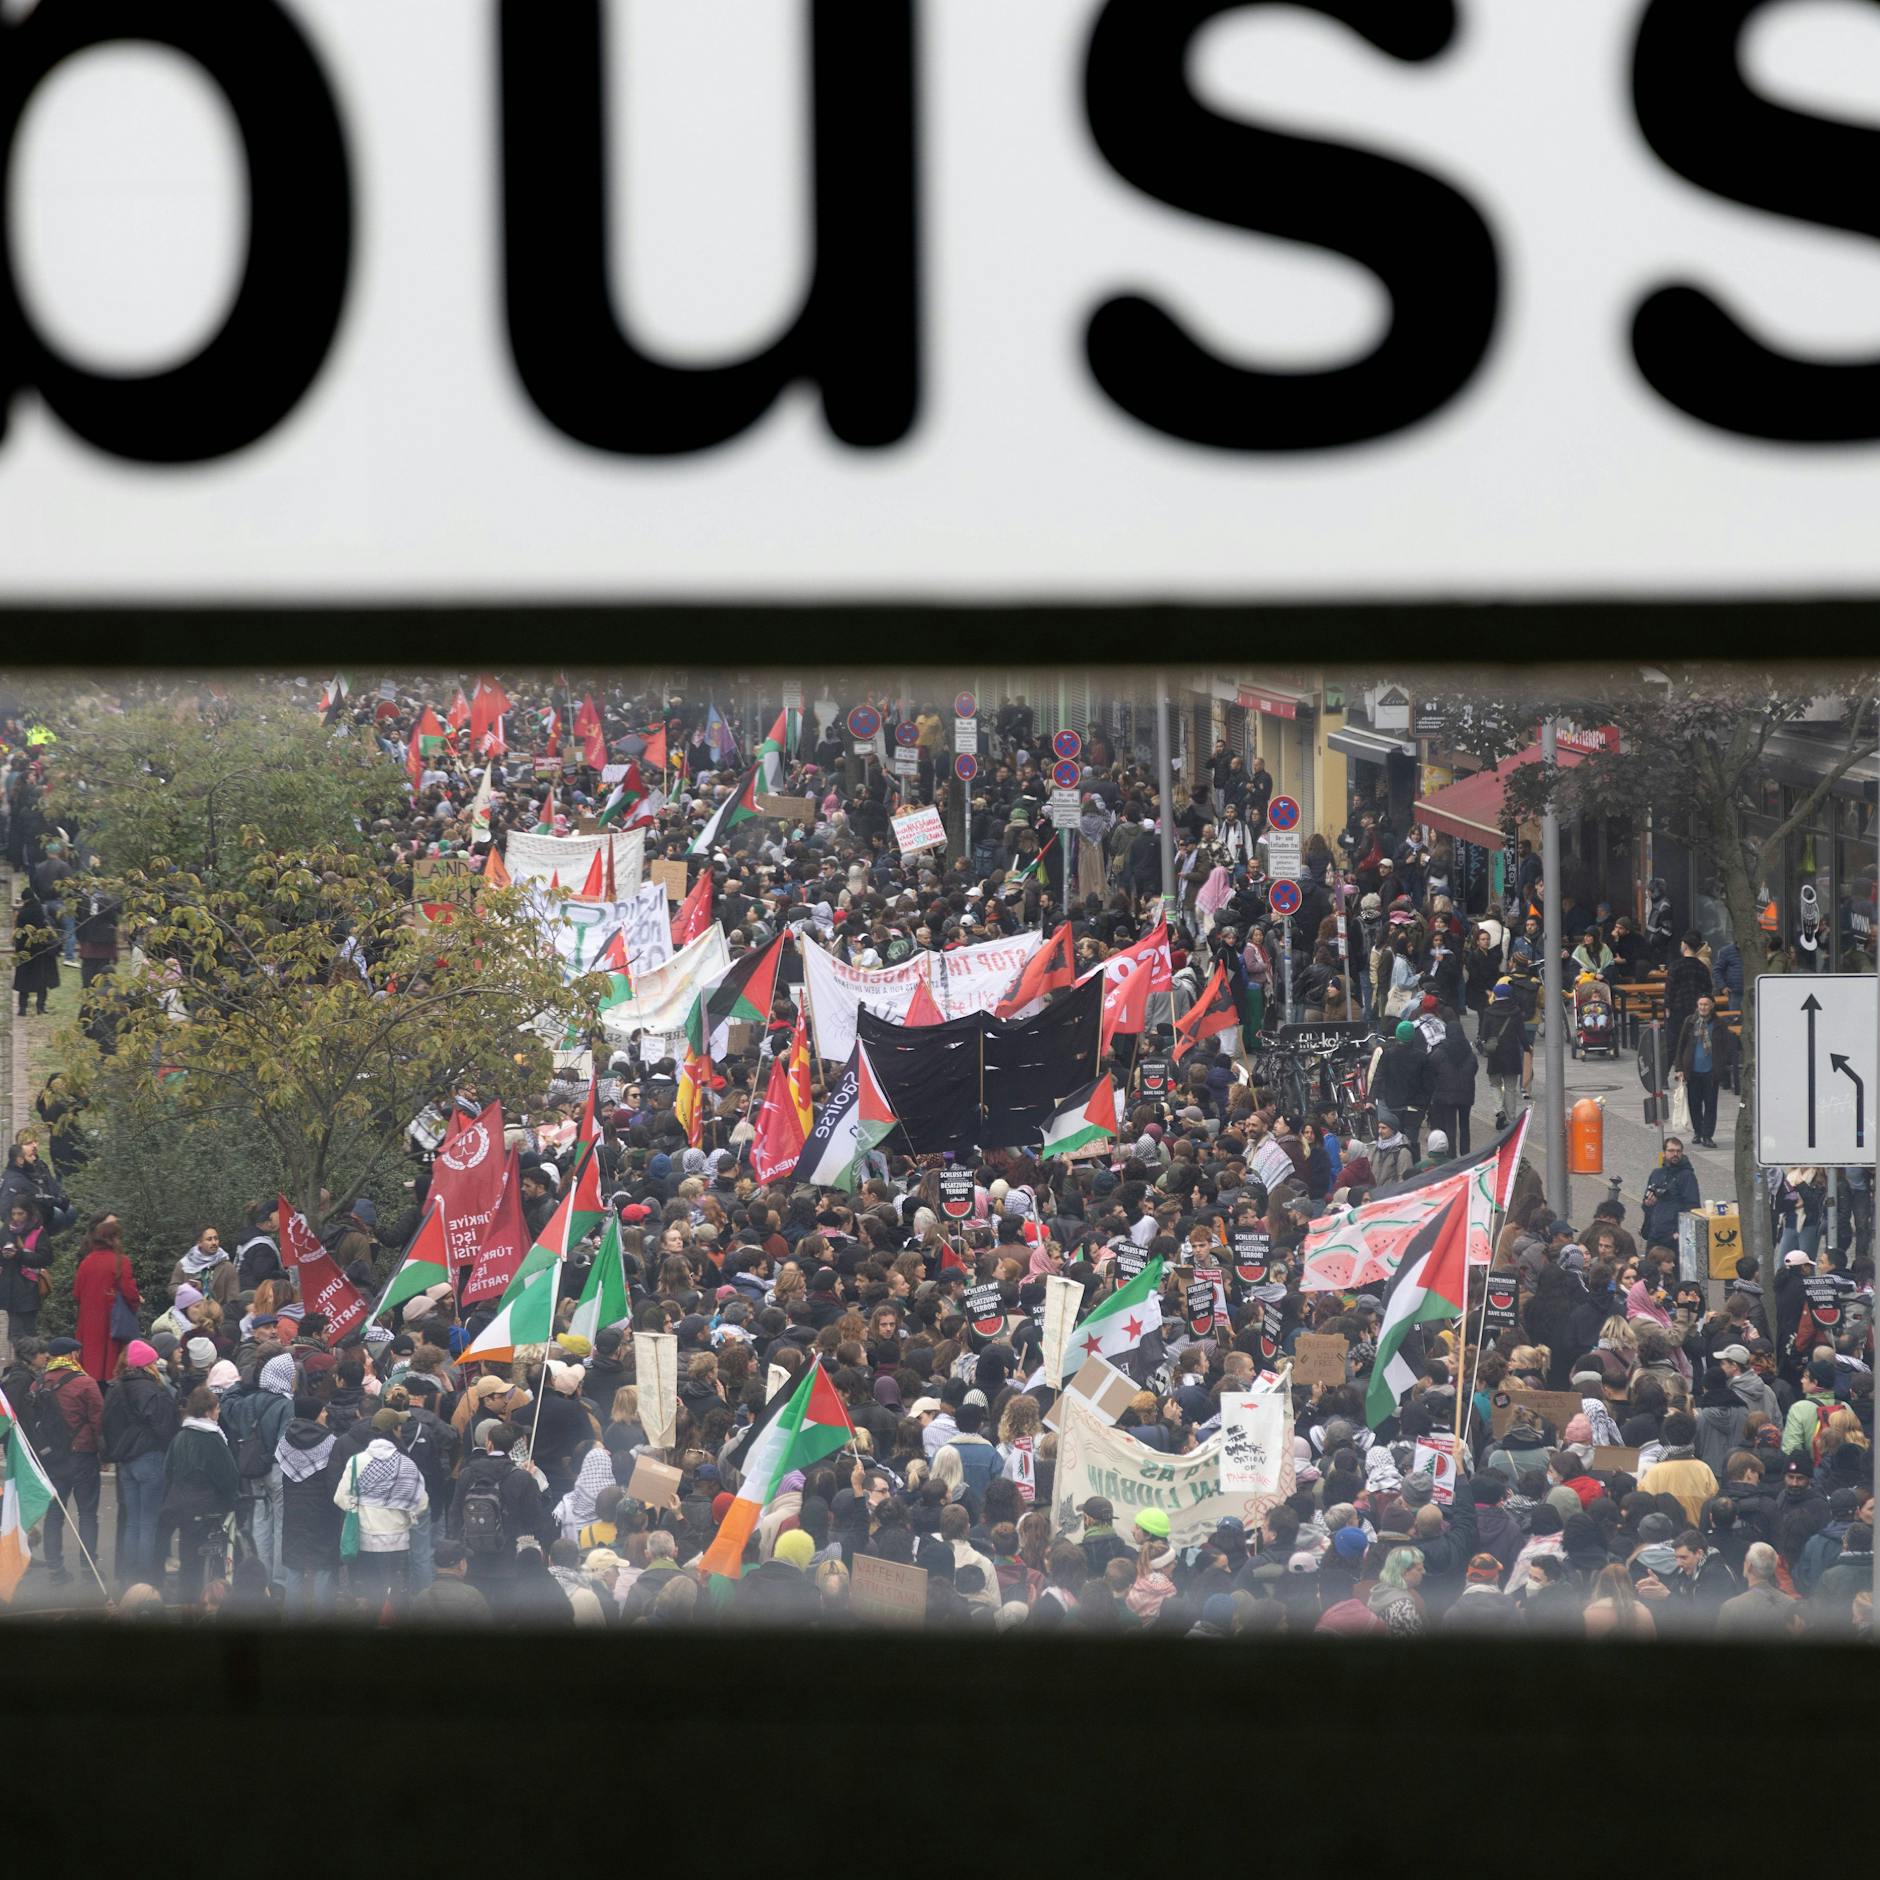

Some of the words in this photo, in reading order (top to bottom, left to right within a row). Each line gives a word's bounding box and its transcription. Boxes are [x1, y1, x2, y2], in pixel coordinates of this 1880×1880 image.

[940, 1171, 963, 1179] SCHLUSS
[963, 1170, 973, 1178] MIT
[940, 1181, 973, 1189] BESATZUNGS
[1235, 1233, 1257, 1241] SCHLUSS
[1118, 1244, 1139, 1255] SCHLUSS
[1235, 1245, 1269, 1253] BESATZUNGS
[963, 1284, 988, 1296] SCHLUSS
[988, 1282, 999, 1291] MIT
[966, 1294, 1001, 1308] BESATZUNGS
[973, 1302, 997, 1313] TERROR!
